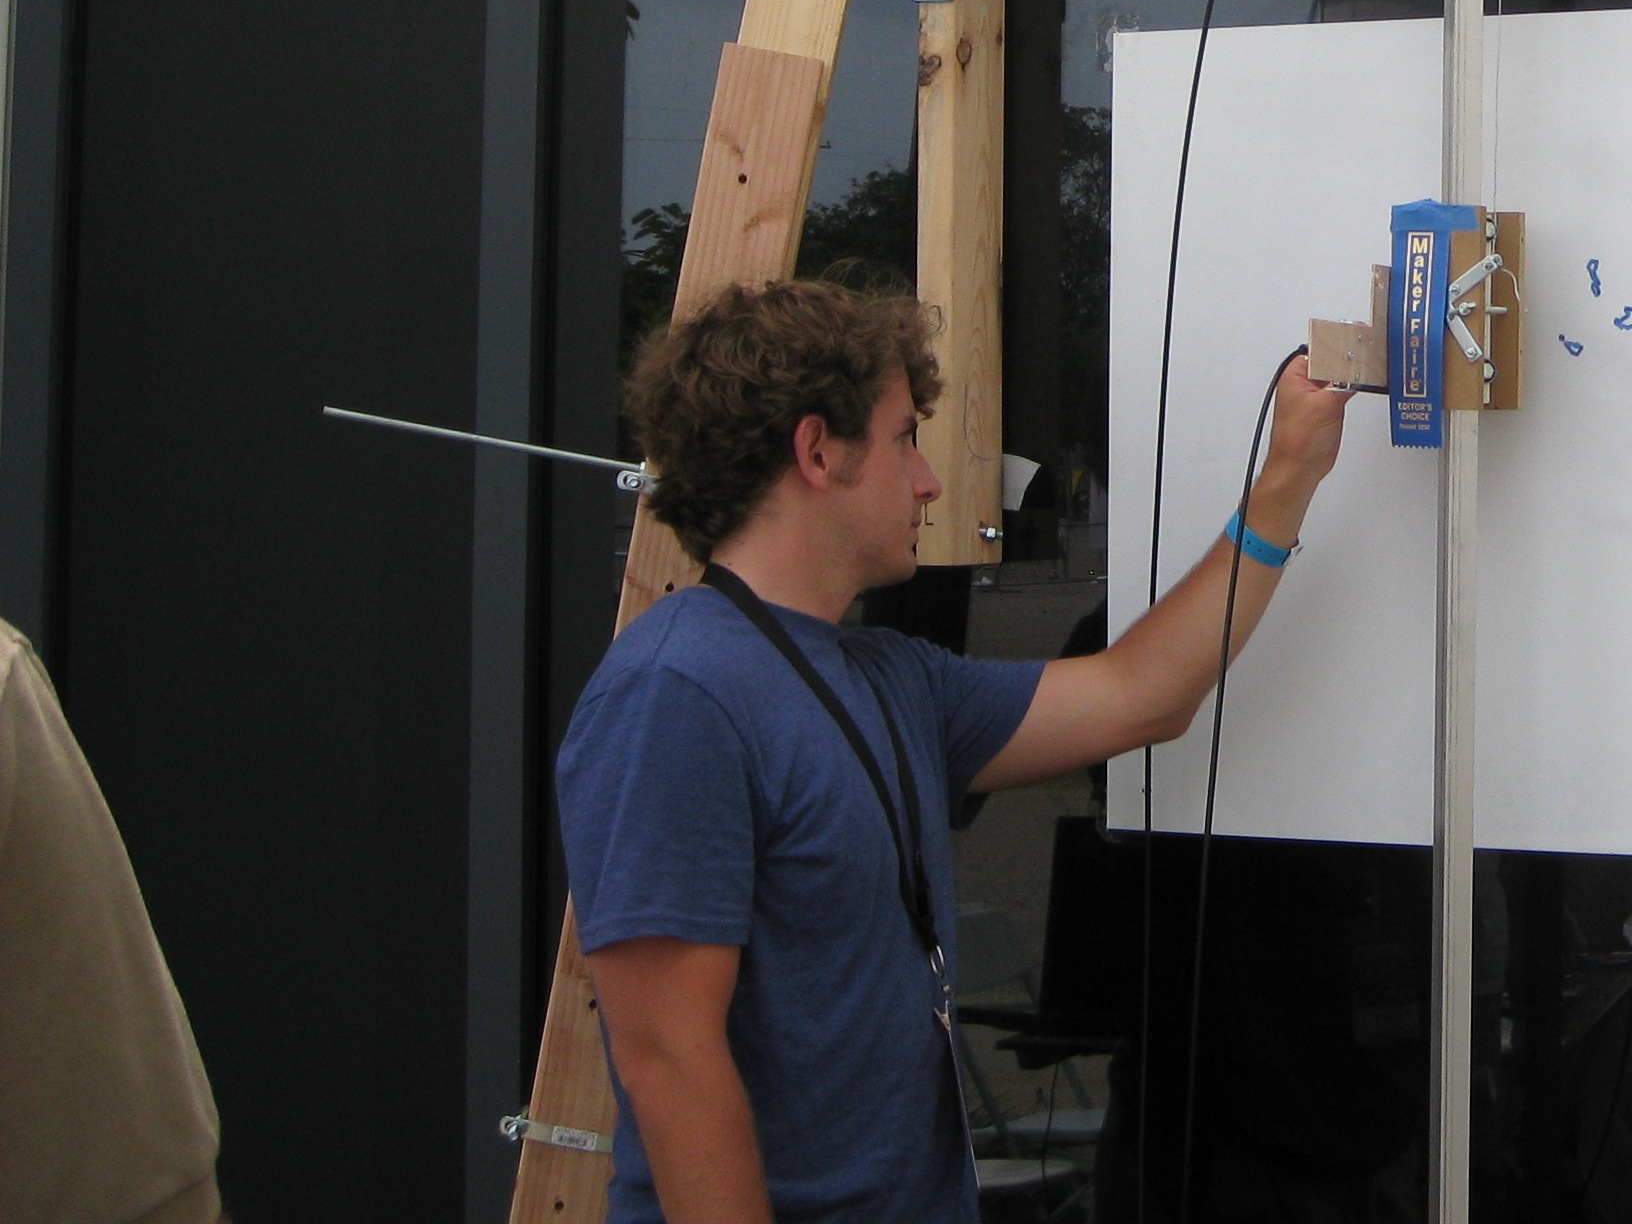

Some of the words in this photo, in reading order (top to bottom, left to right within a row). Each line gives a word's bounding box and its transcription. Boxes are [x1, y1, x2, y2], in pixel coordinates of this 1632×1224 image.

[1411, 237, 1429, 312] Maker
[1409, 318, 1422, 392] Faire
[1400, 411, 1430, 421] CHOICE
